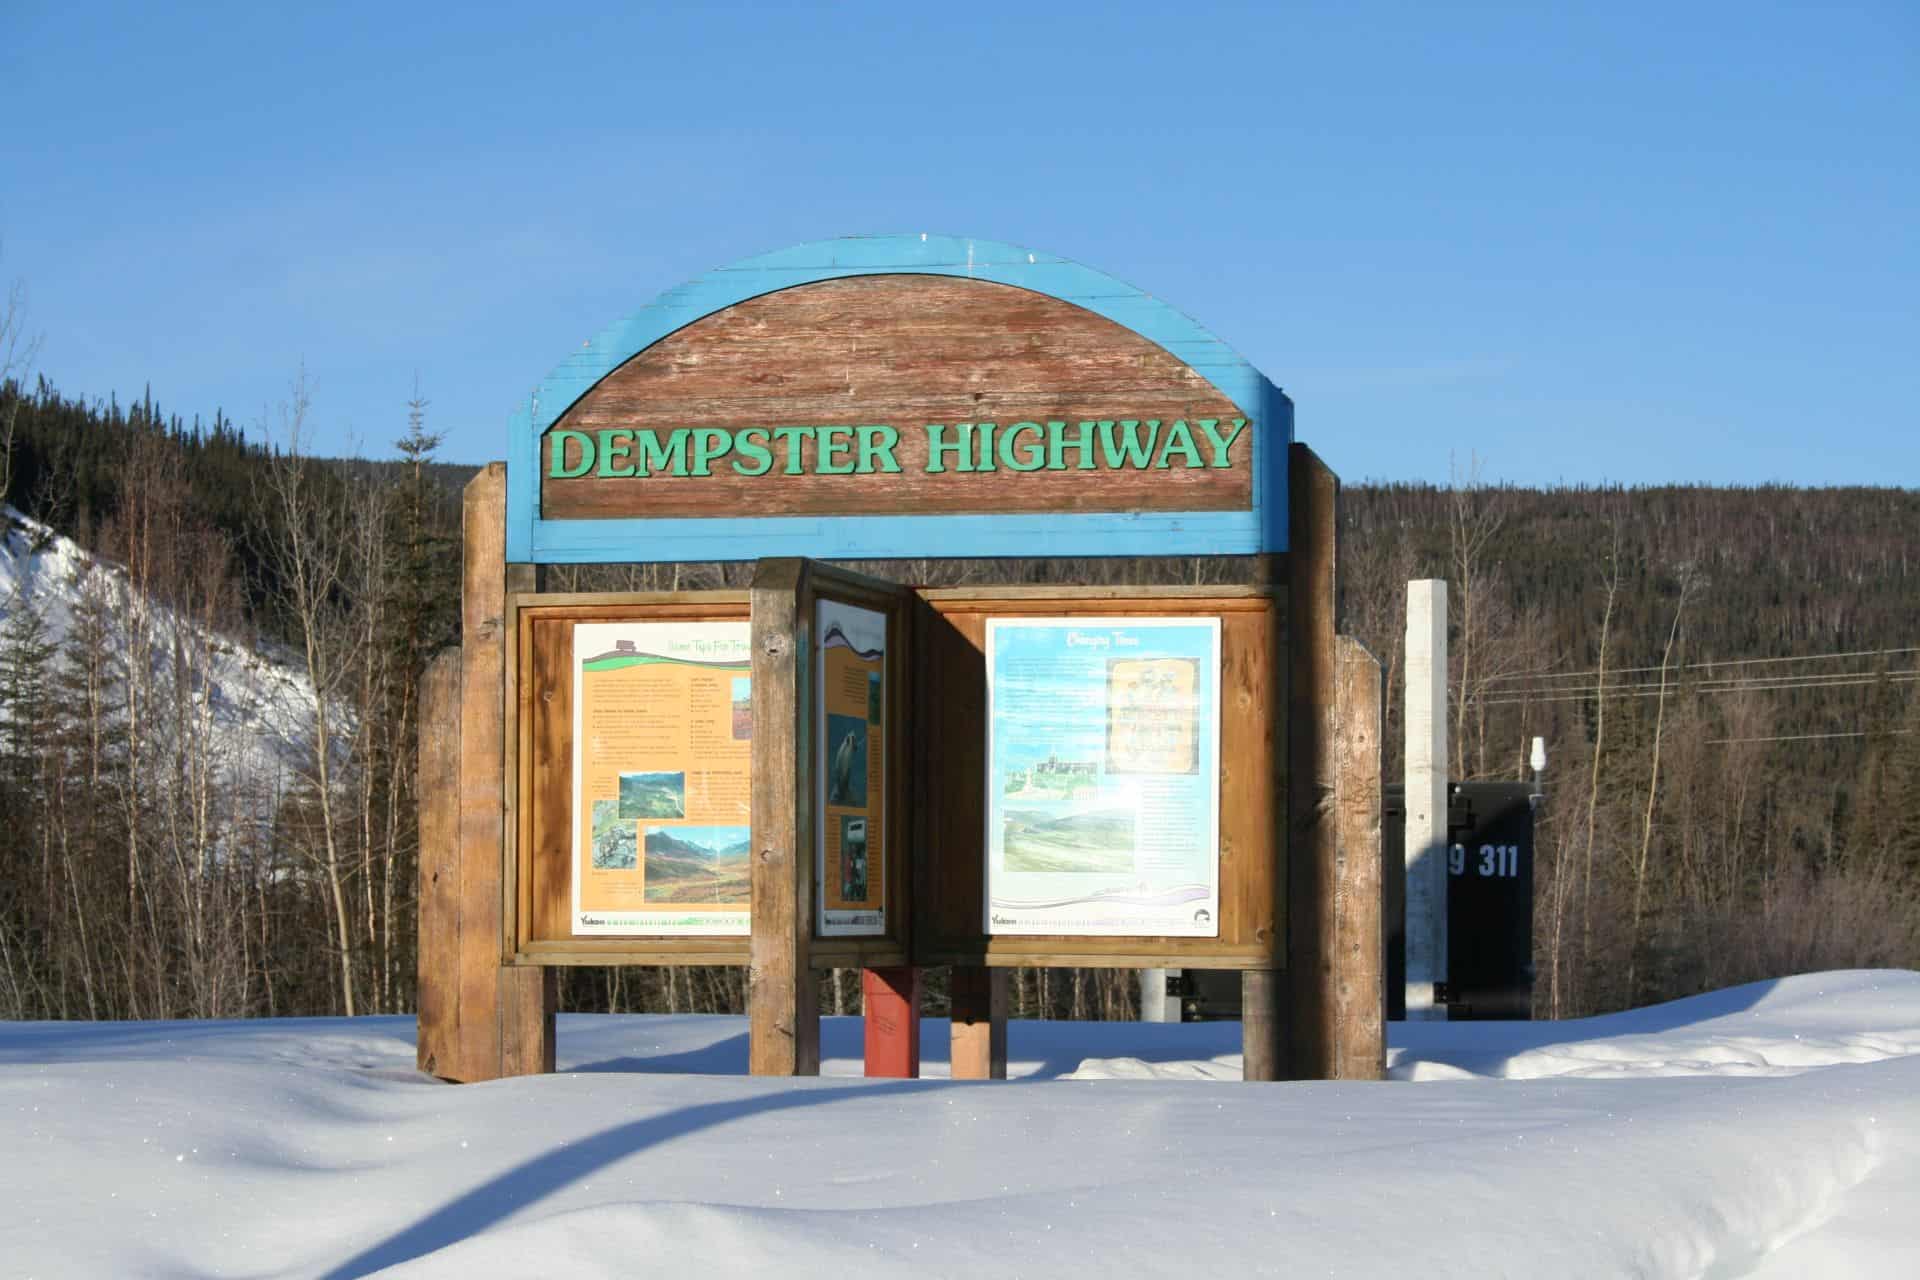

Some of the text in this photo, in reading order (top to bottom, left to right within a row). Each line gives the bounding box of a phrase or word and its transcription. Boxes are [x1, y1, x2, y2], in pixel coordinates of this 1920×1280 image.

[549, 419, 1247, 478] DEMPSTER HIGHWAY
[1450, 844, 1519, 877] 9 311
